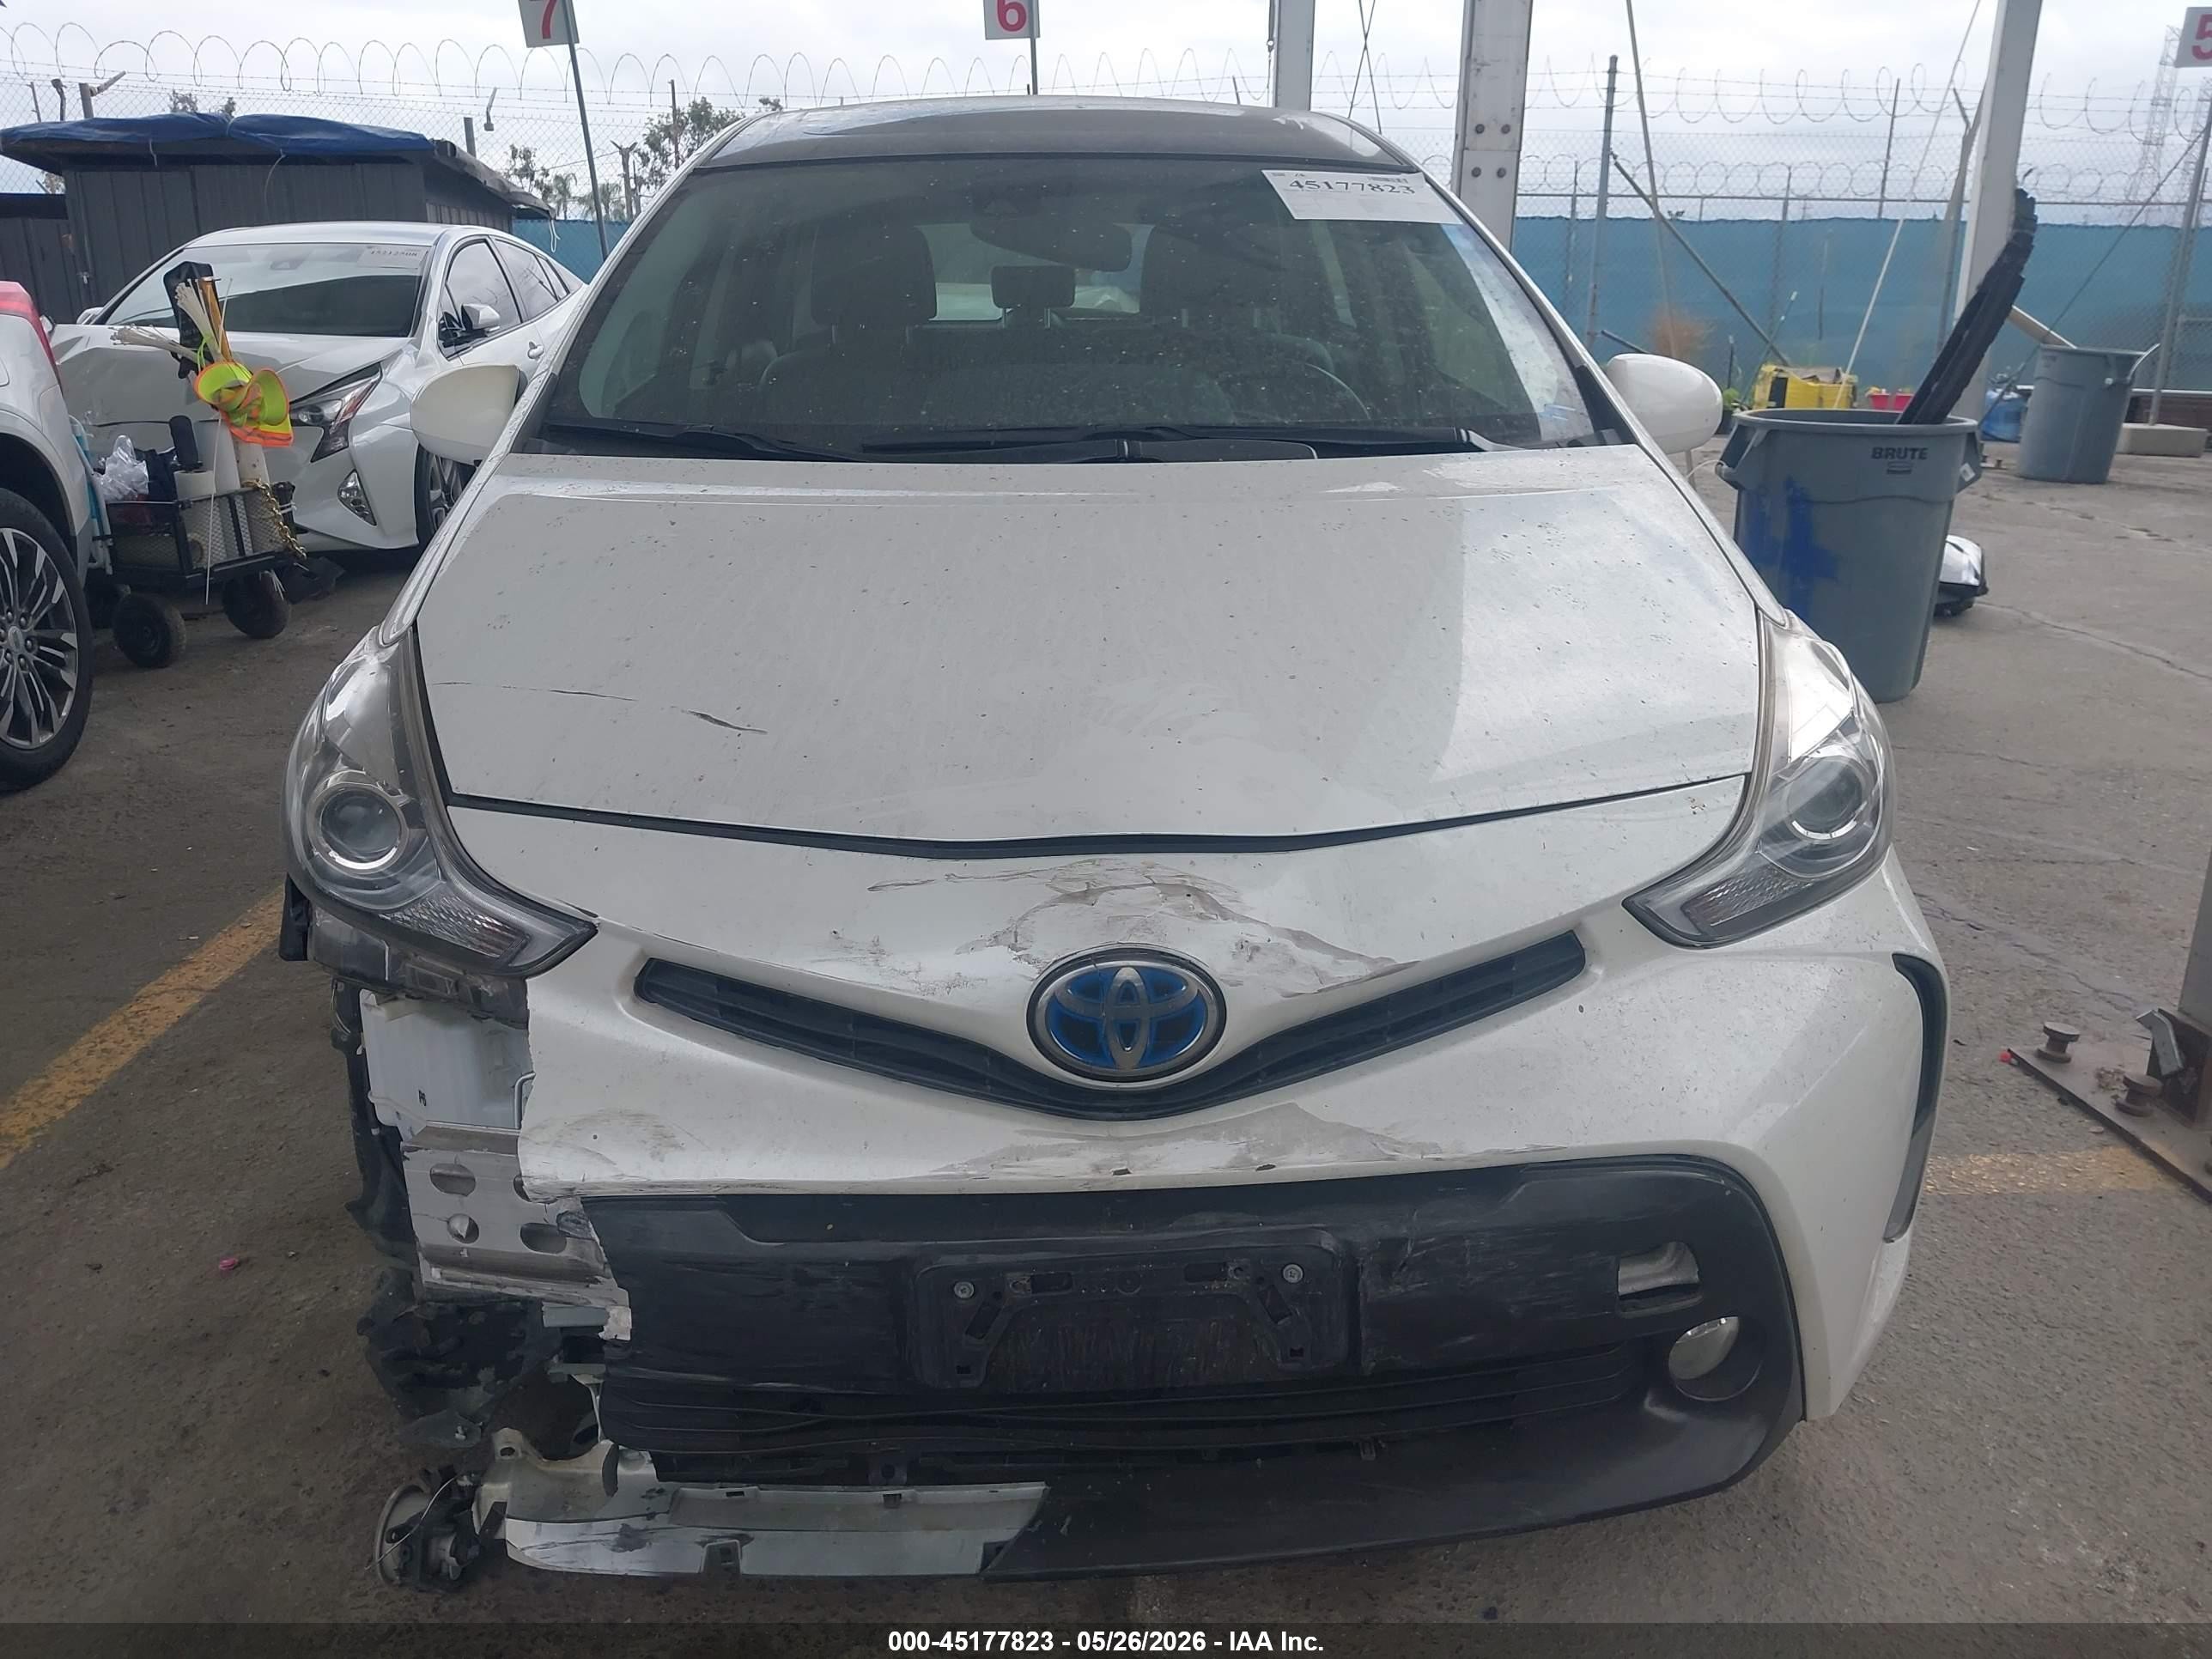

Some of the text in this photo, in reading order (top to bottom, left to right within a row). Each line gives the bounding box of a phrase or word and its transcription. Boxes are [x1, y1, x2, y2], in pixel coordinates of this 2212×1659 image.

[997, 0, 1027, 32] 6
[2191, 14, 2212, 60] 5
[1290, 179, 1416, 194] 45177823
[1871, 447, 1929, 460] BRUTE
